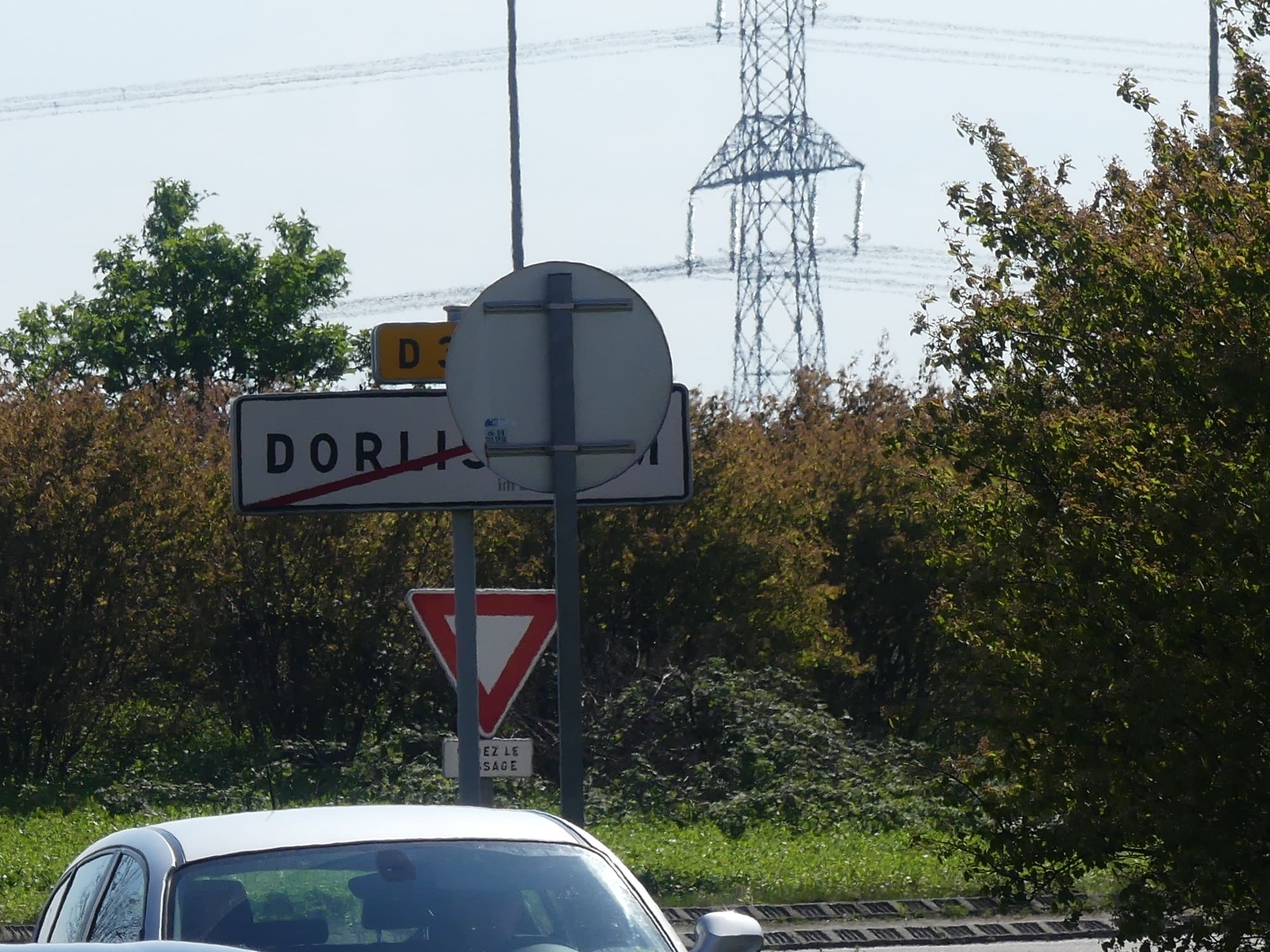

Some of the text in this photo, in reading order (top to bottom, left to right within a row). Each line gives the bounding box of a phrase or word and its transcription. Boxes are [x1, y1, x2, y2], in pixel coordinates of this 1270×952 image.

[483, 746, 519, 756] EZ LE
[480, 761, 518, 771] SAGE
